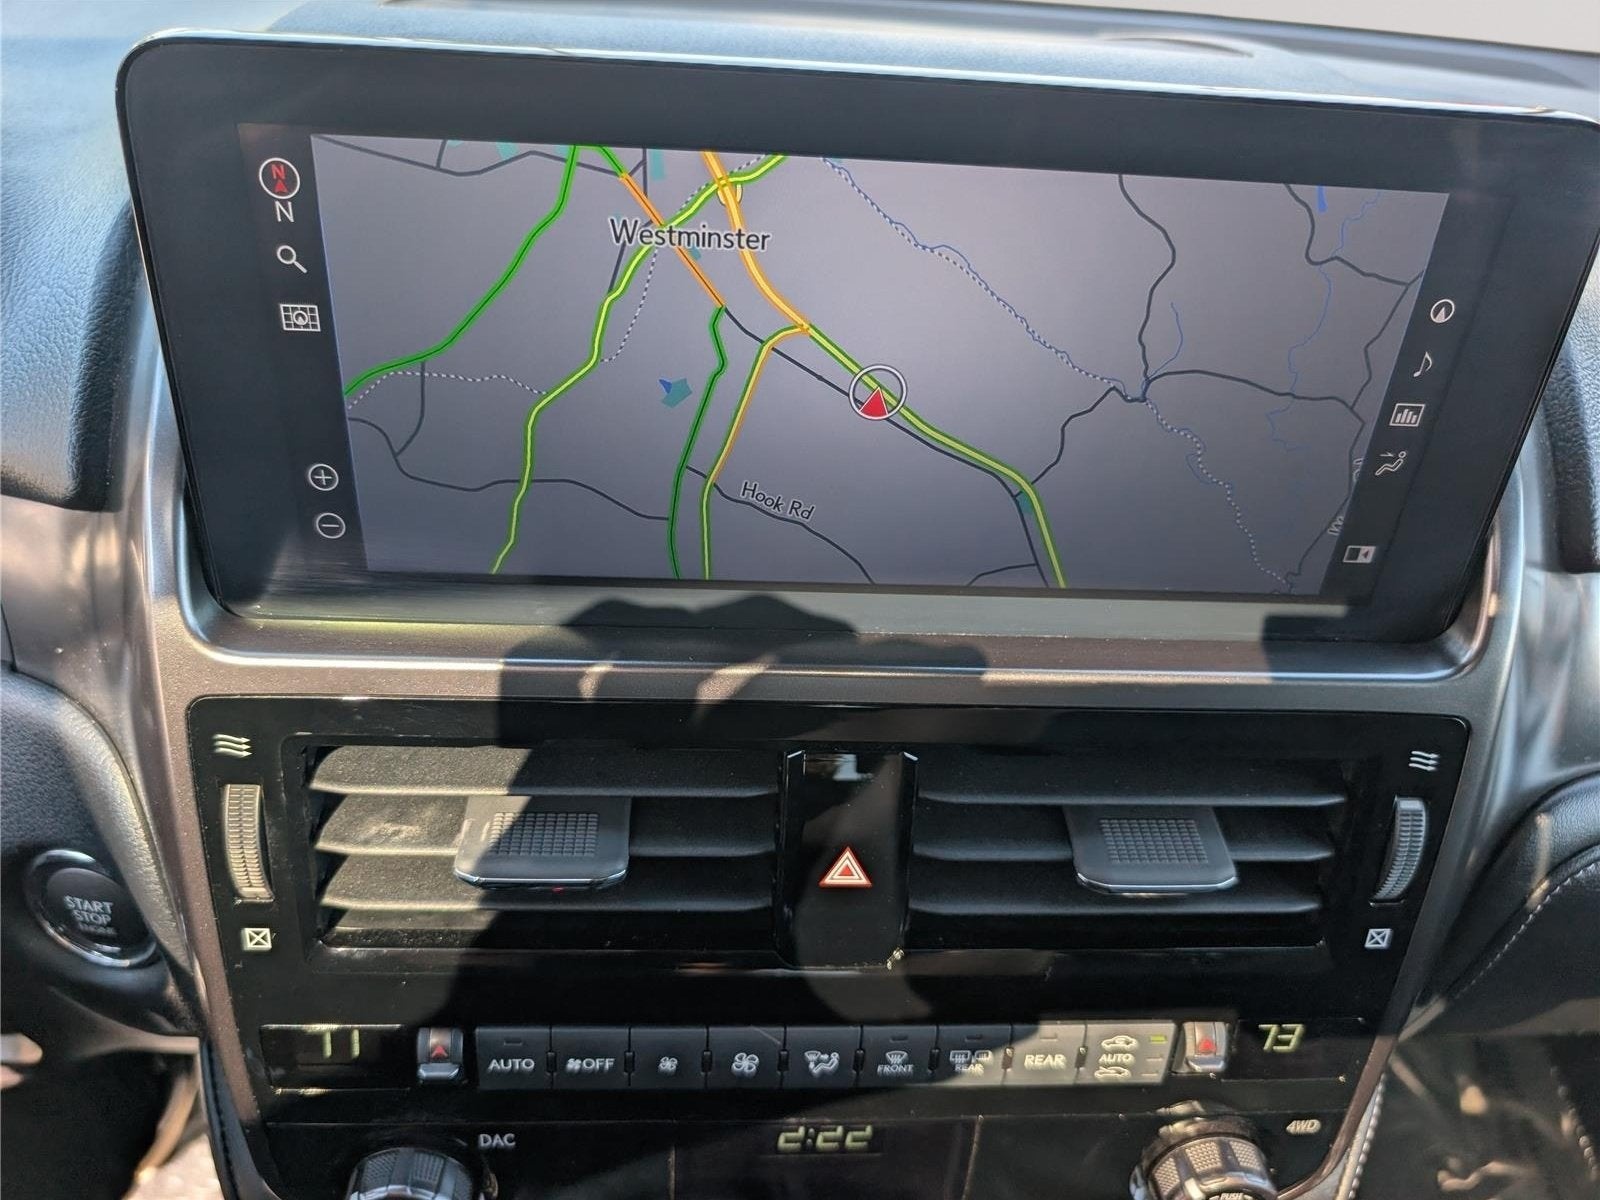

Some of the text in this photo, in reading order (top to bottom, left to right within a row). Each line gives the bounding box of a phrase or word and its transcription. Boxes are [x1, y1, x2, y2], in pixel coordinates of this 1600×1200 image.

[271, 163, 286, 180] N
[275, 200, 295, 223] N
[609, 216, 771, 251] Westminster
[741, 481, 815, 520] Hook Rd
[64, 895, 114, 914] START
[72, 909, 111, 926] STOP
[1258, 1023, 1305, 1052] 73
[487, 1058, 535, 1072] AUTO
[582, 1058, 615, 1071] OFF
[1023, 1053, 1067, 1070] REAR
[1099, 1053, 1135, 1066] AUTO
[877, 1063, 914, 1075] FRONT
[955, 1063, 984, 1075] REAR
[1286, 1119, 1321, 1134] 4WD
[478, 1132, 516, 1149] DAC
[777, 1124, 873, 1153] 2:22
[1220, 1192, 1243, 1200] PUSH
